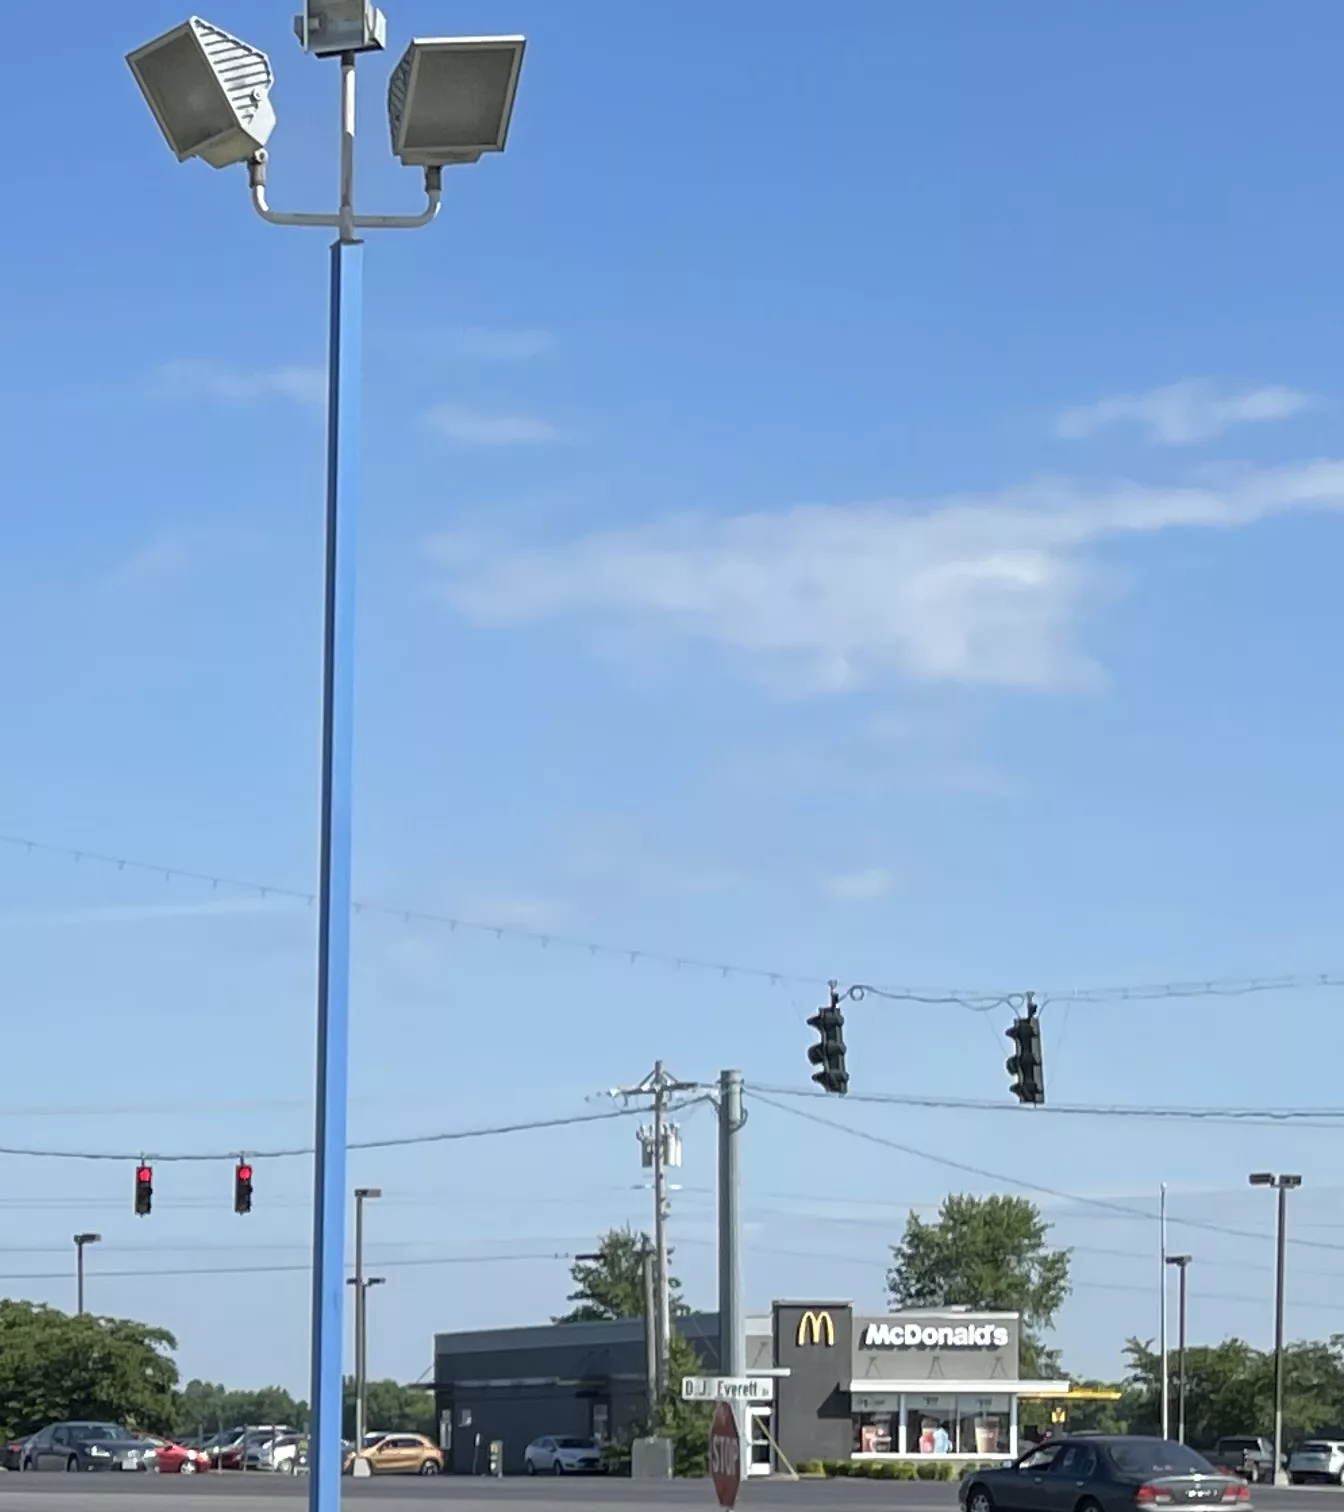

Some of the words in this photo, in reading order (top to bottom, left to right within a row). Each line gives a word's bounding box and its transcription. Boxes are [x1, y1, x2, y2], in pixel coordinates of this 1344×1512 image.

[864, 1323, 1009, 1346] McDonald's
[717, 1380, 758, 1397] Everett
[712, 1435, 738, 1476] STOP
